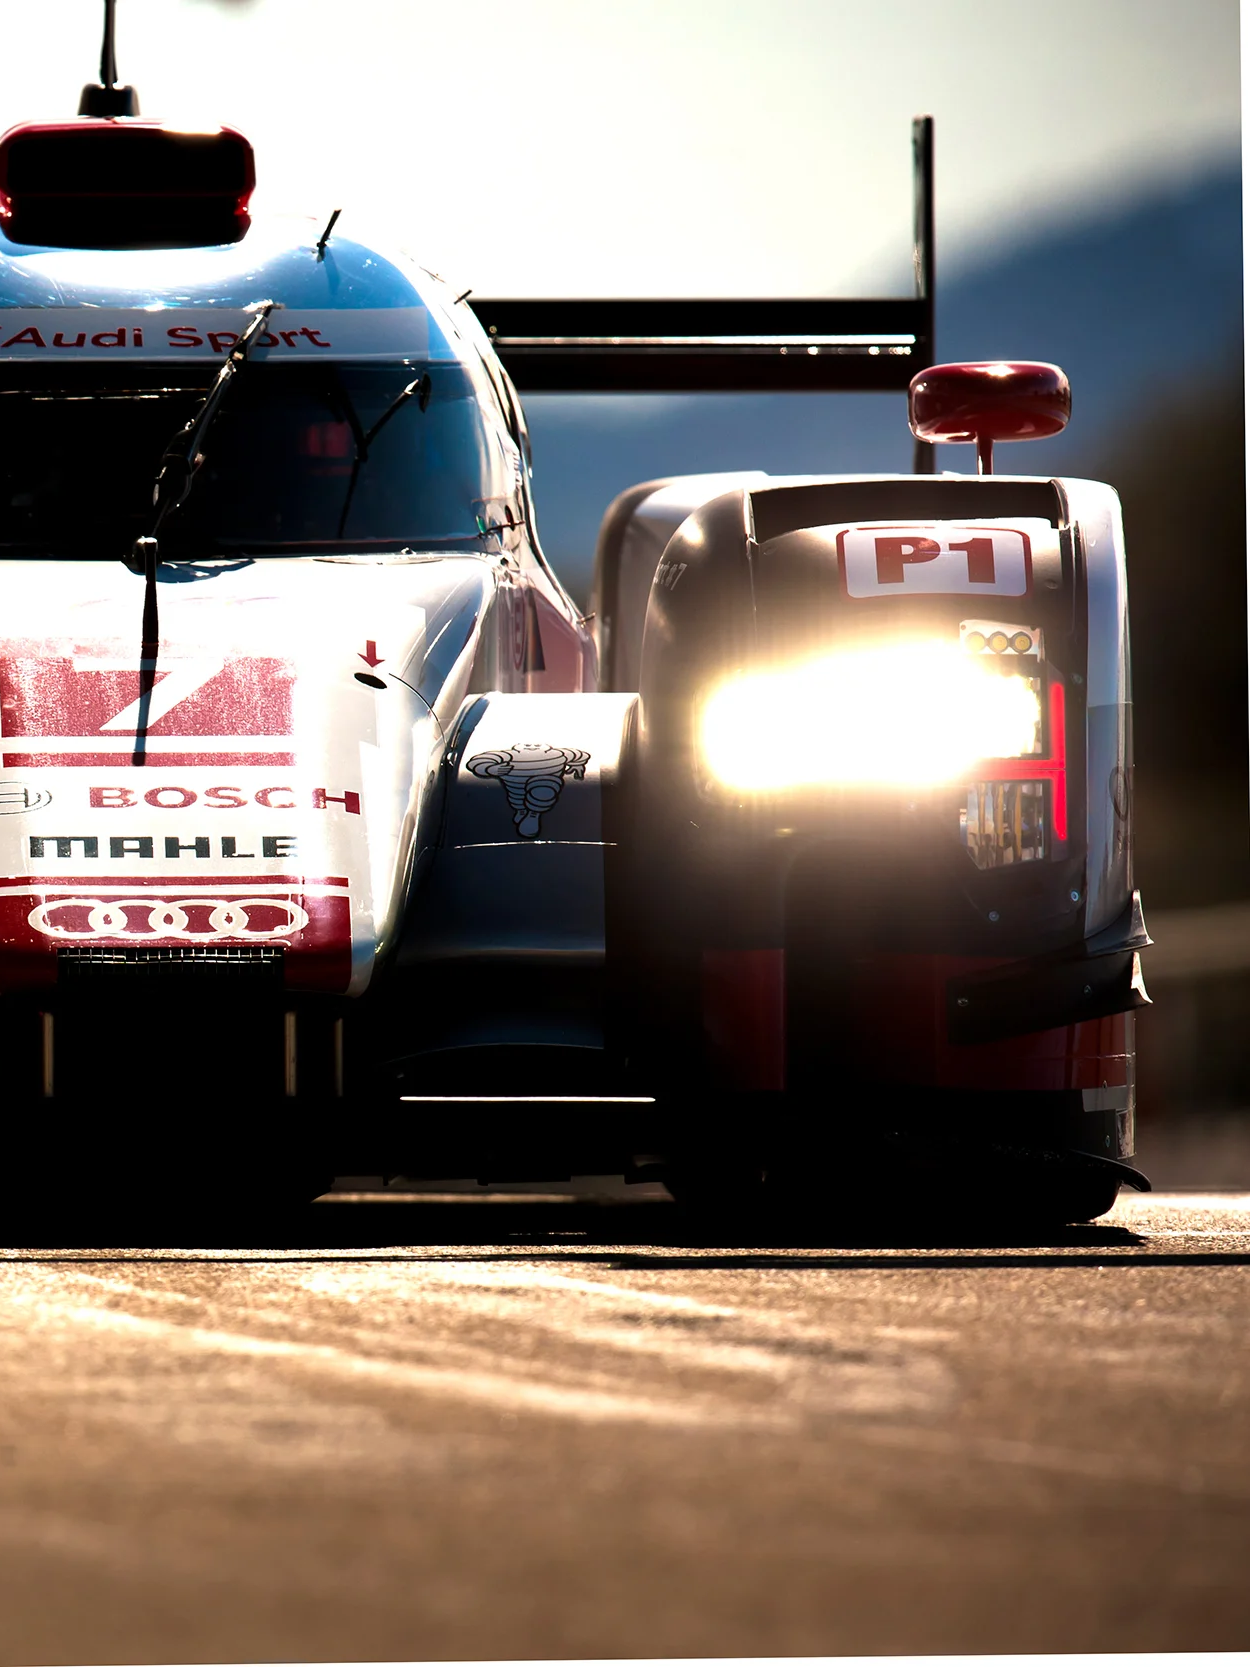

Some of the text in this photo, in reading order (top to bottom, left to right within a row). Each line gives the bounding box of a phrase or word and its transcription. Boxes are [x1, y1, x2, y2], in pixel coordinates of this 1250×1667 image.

[0, 326, 332, 353] Audi Sport
[874, 536, 996, 584] P1
[72, 656, 226, 731] 7
[89, 786, 361, 815] BOSCH
[29, 836, 299, 859] MAHLE
